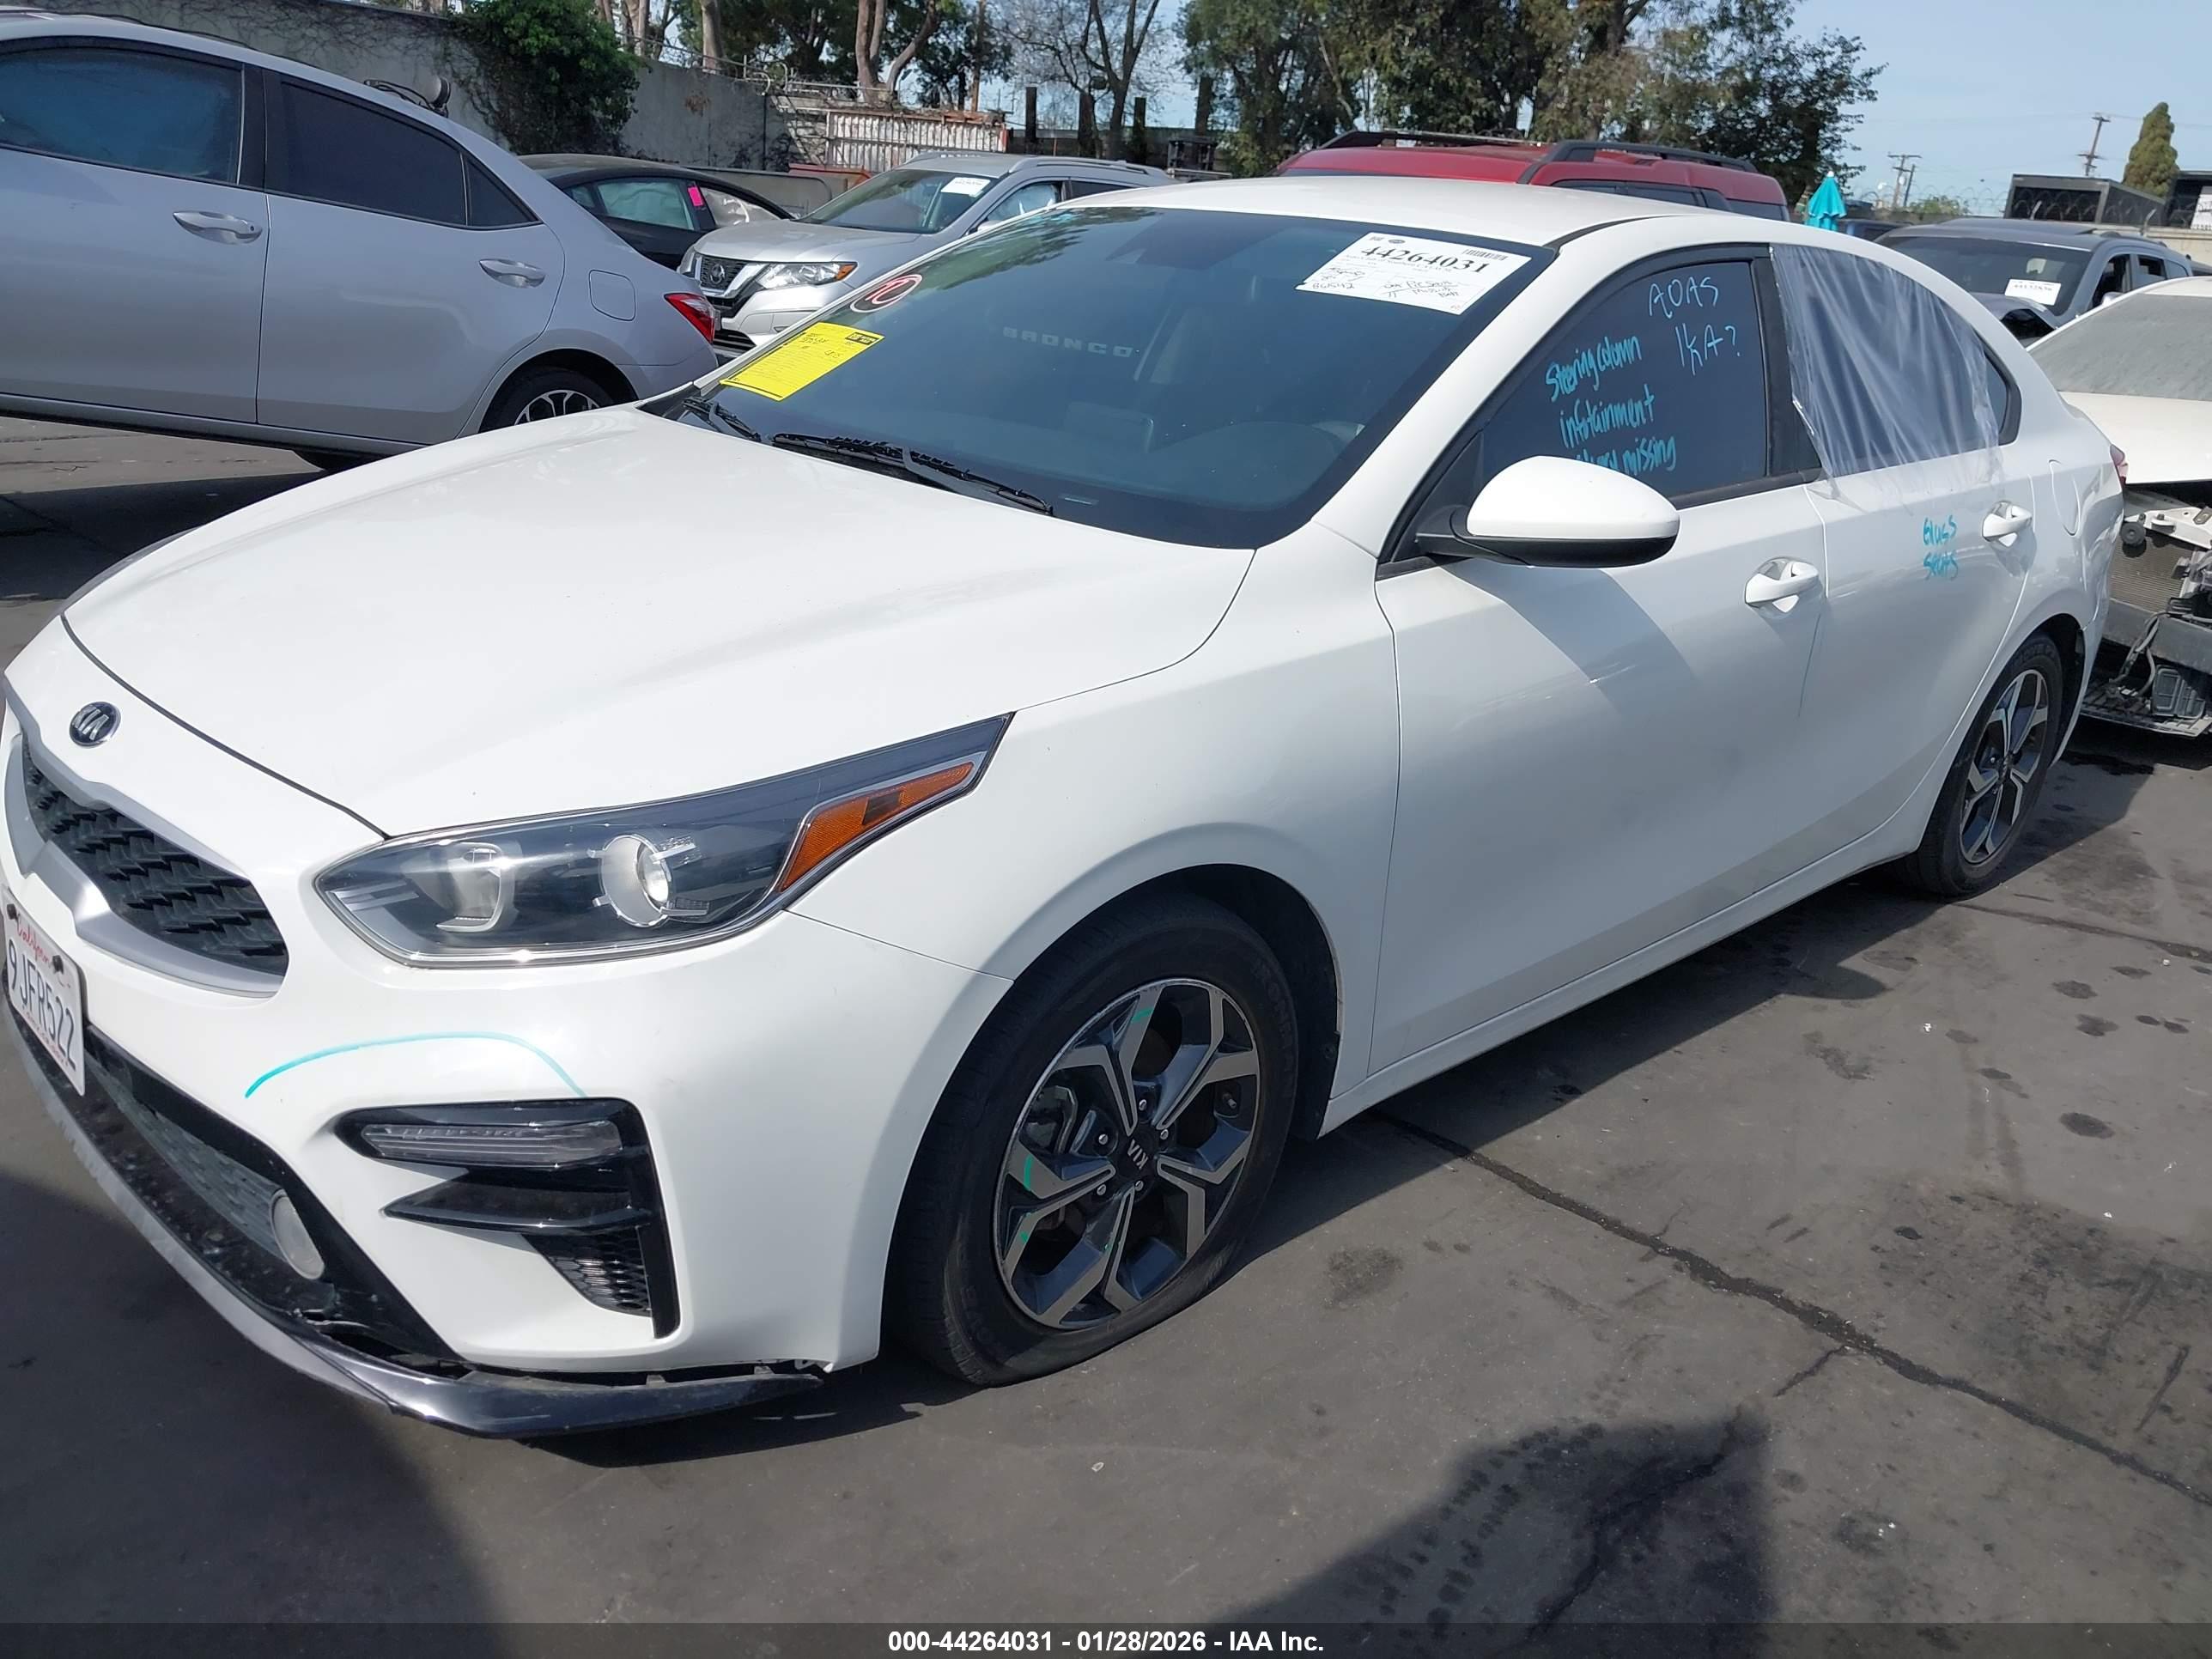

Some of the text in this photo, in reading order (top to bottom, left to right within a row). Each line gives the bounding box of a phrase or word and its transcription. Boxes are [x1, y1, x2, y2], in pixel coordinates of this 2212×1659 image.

[1361, 246, 1491, 273] 44264031
[1003, 326, 1133, 357] BRONCO
[1127, 1139, 1149, 1170] KIA
